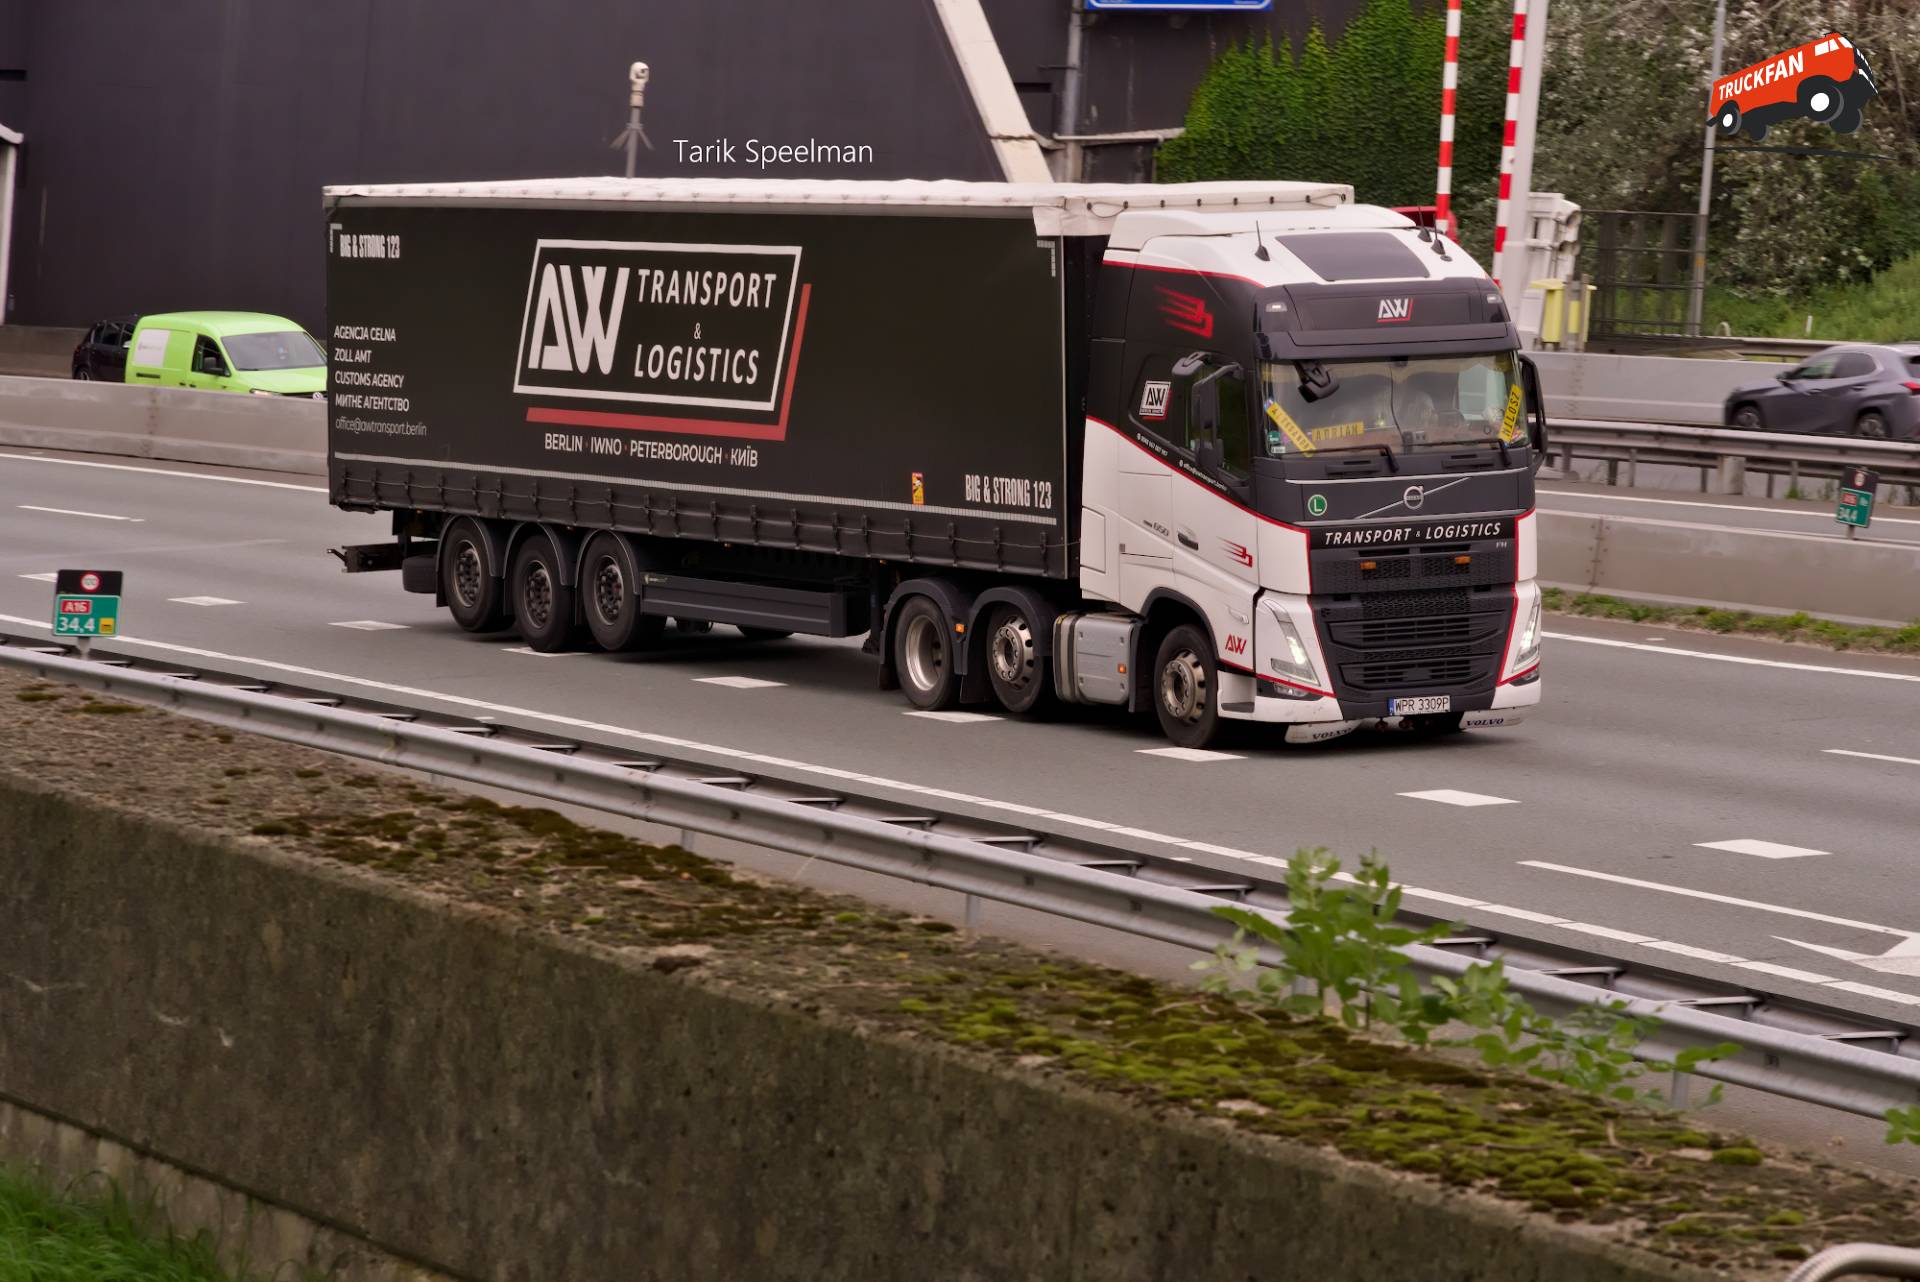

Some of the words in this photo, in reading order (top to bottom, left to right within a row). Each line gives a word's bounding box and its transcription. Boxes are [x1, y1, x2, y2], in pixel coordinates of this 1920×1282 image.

[340, 234, 351, 257] BIG
[352, 234, 358, 258] &
[359, 234, 385, 258] STRONG
[387, 235, 400, 258] 123
[638, 268, 776, 308] TRANSPORT
[1378, 298, 1409, 318] AW
[528, 263, 630, 375] AW
[333, 325, 369, 340] AGENCJA
[370, 327, 396, 342] CELNA
[693, 322, 701, 340] &
[335, 348, 354, 362] ZOLL
[354, 350, 372, 363] AMT
[634, 344, 759, 385] LOGISTICS
[335, 371, 371, 386] CUSTOMS
[371, 374, 404, 388] AGENCY
[335, 393, 362, 408] МИТНЕ
[363, 396, 409, 412] АГЕНТСТВО
[1146, 387, 1166, 406] AW
[336, 416, 427, 435] office@awtransport.berlin
[545, 433, 583, 452] BERLIN
[590, 437, 622, 456] IWNO
[630, 439, 722, 465] PETERBOROUGH
[965, 474, 980, 502] BIG
[984, 475, 990, 504] &
[993, 477, 1031, 507] STRONG
[1033, 480, 1052, 509] 123
[1325, 527, 1411, 545] TRANSPORT
[1426, 522, 1501, 541] LOGISTICS
[1225, 634, 1247, 655] AW
[1395, 699, 1414, 711] WPR
[1418, 697, 1448, 710] 3309P
[1466, 717, 1504, 727] VOLVO
[1313, 727, 1352, 739] VOLVO
